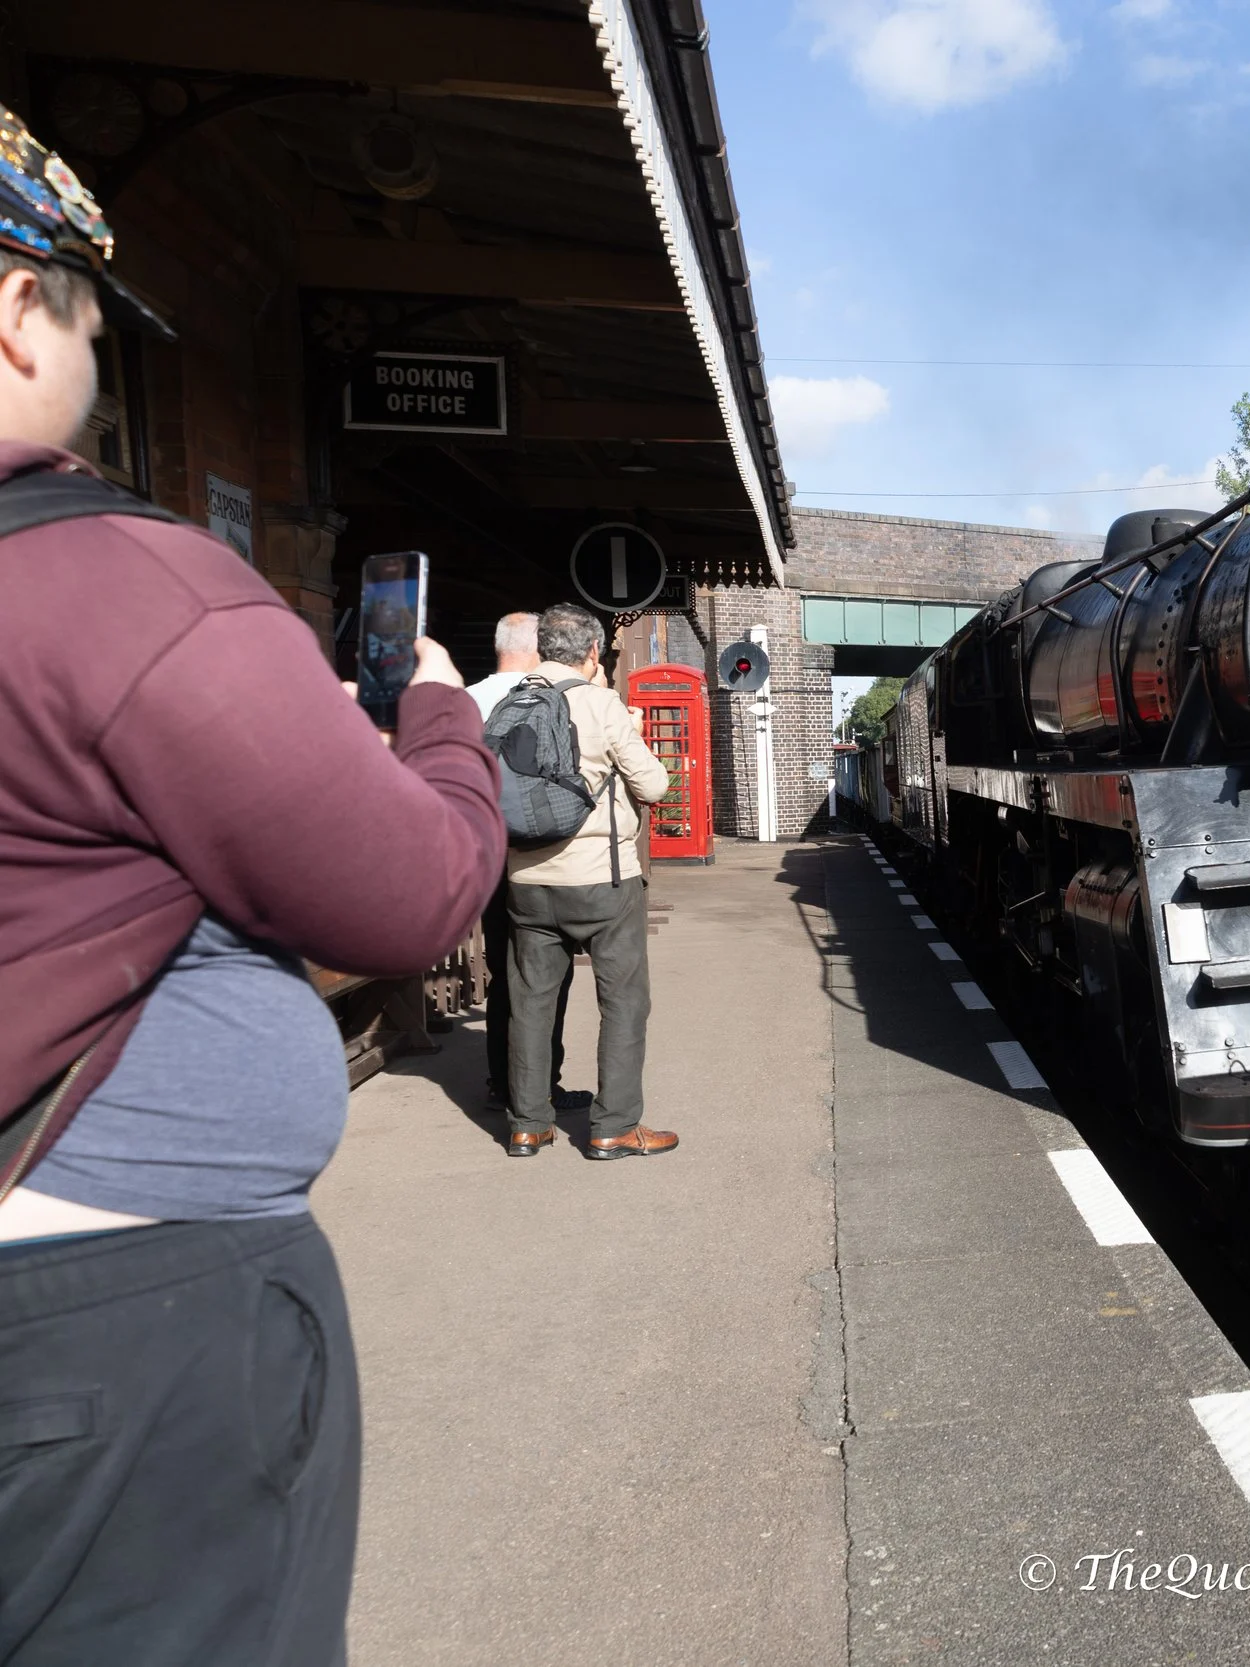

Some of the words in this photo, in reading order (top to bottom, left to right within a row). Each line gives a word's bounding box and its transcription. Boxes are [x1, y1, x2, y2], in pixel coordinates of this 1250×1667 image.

[375, 366, 475, 390] BOOKING
[386, 392, 467, 415] OFFICE
[610, 536, 628, 599] 1
